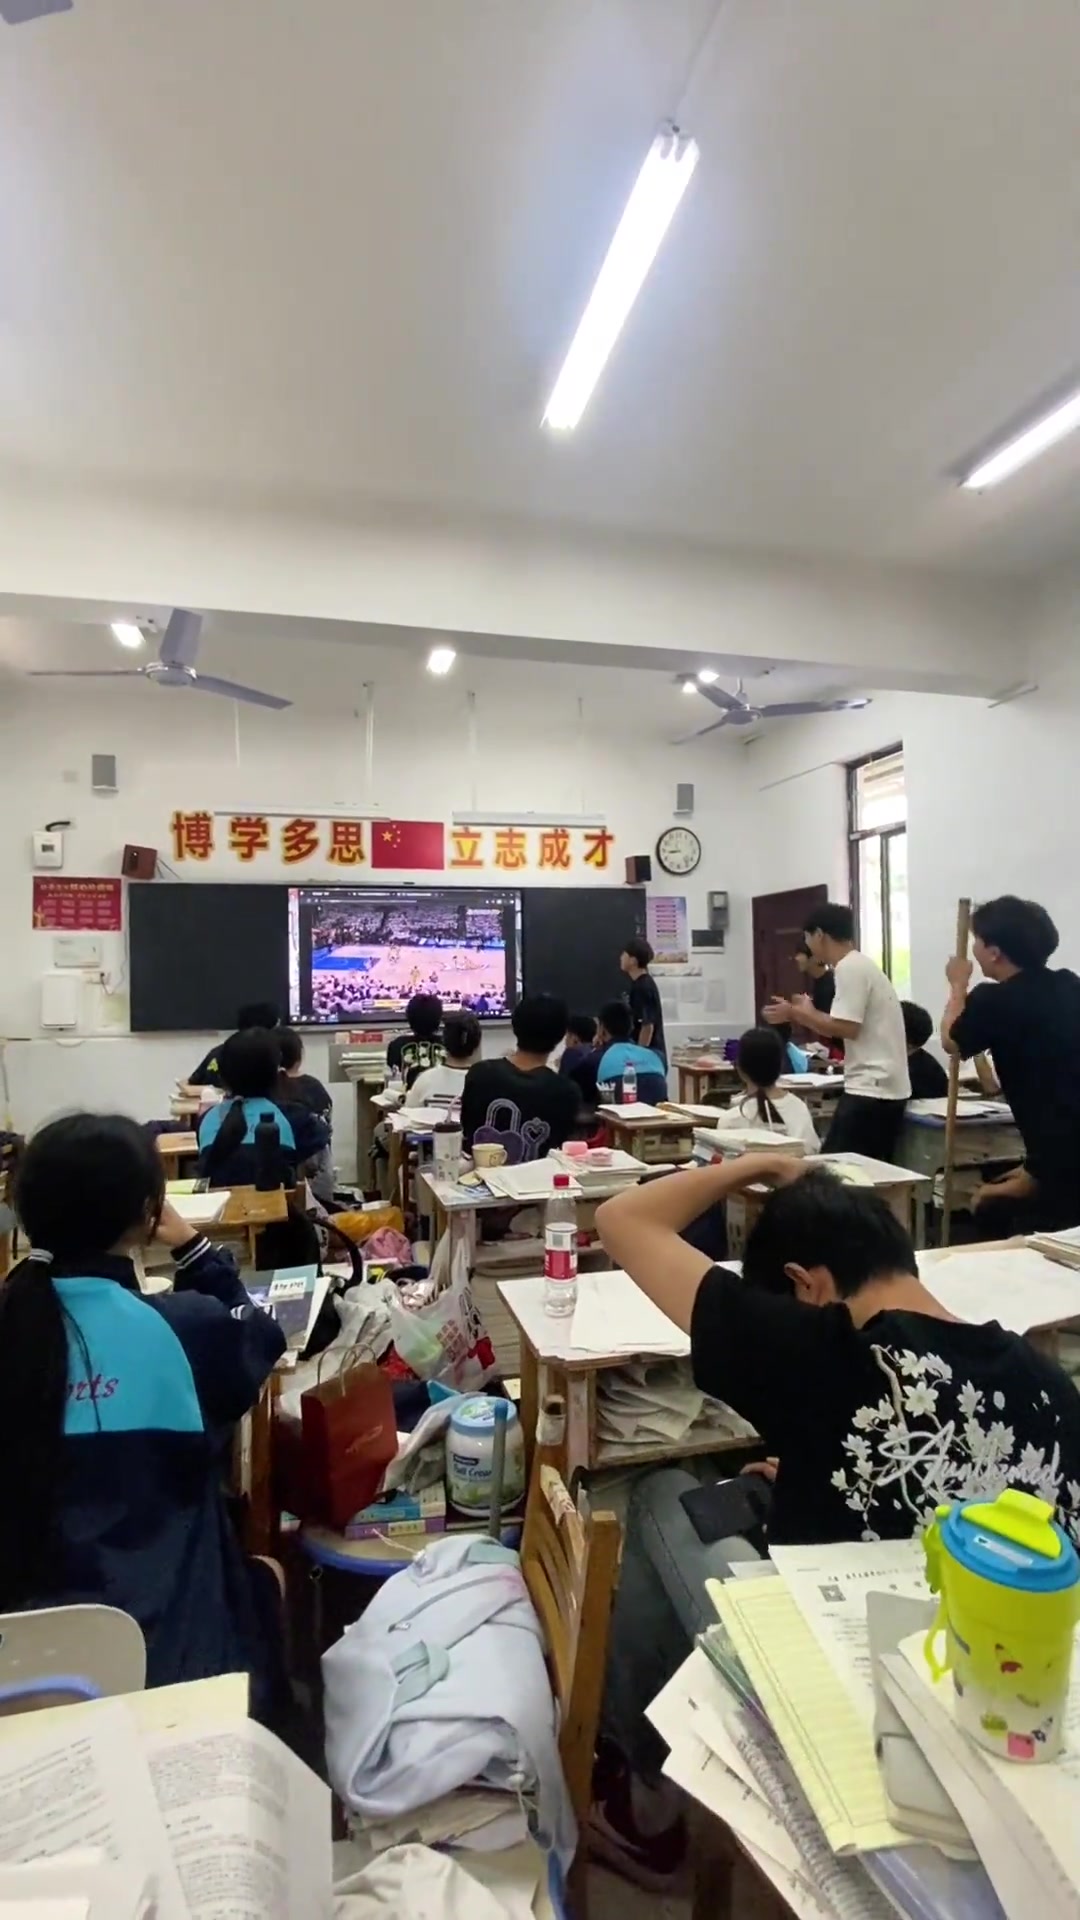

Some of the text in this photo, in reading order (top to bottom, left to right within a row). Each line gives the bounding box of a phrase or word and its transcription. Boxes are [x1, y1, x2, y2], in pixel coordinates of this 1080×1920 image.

[171, 810, 615, 870] 博学多思 立志成才
